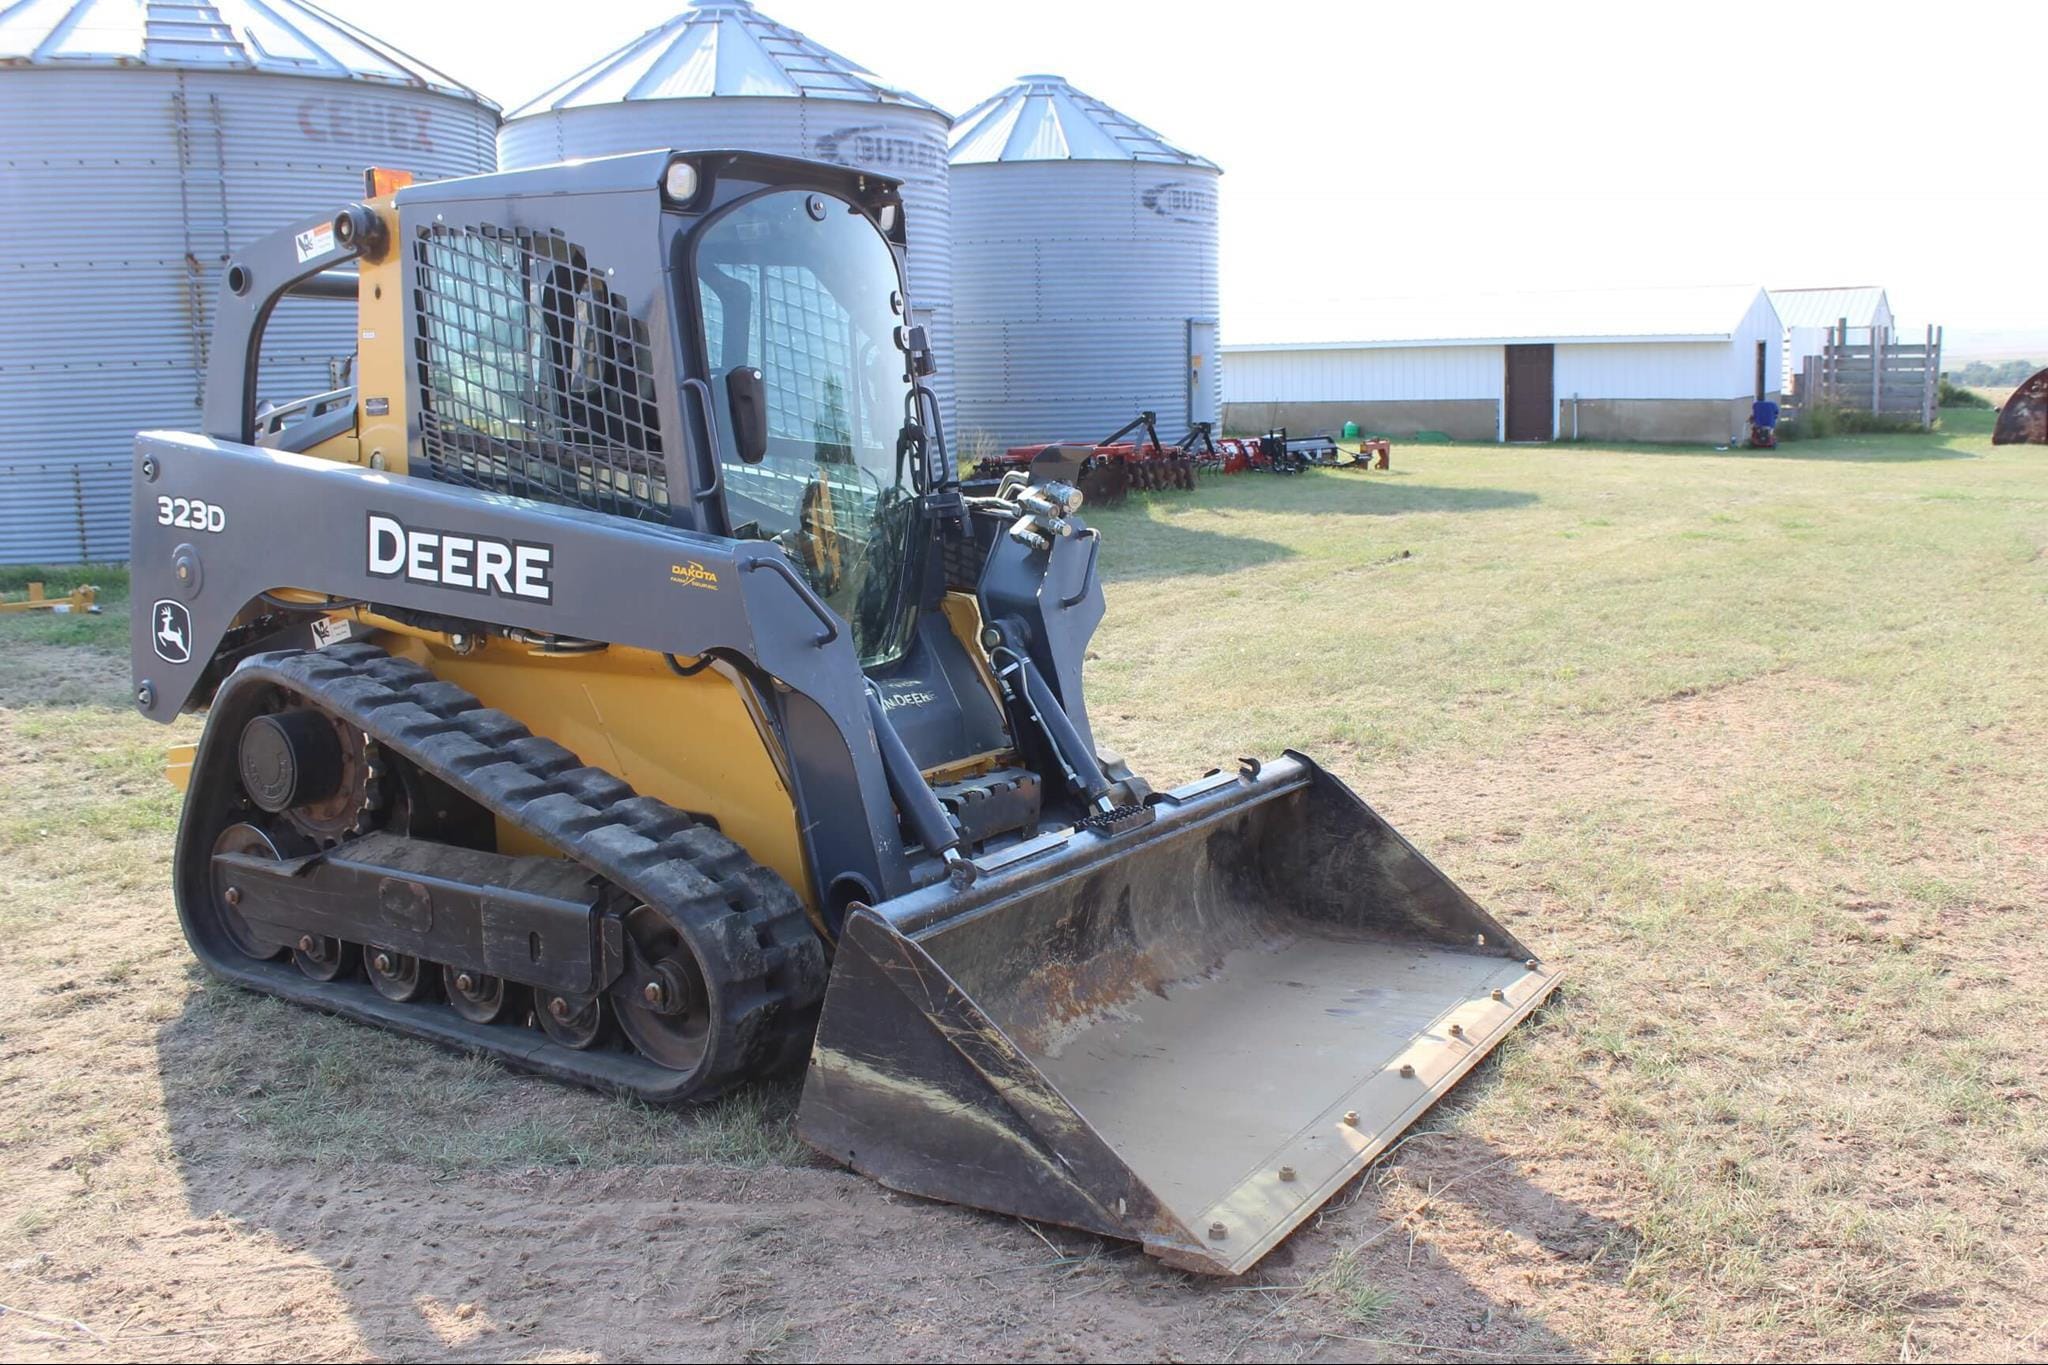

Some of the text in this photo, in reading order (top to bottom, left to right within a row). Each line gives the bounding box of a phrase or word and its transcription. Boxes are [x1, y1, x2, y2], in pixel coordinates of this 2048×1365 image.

[157, 495, 226, 533] 323D
[368, 515, 551, 599] DEERE
[671, 564, 718, 582] DAKOTA
